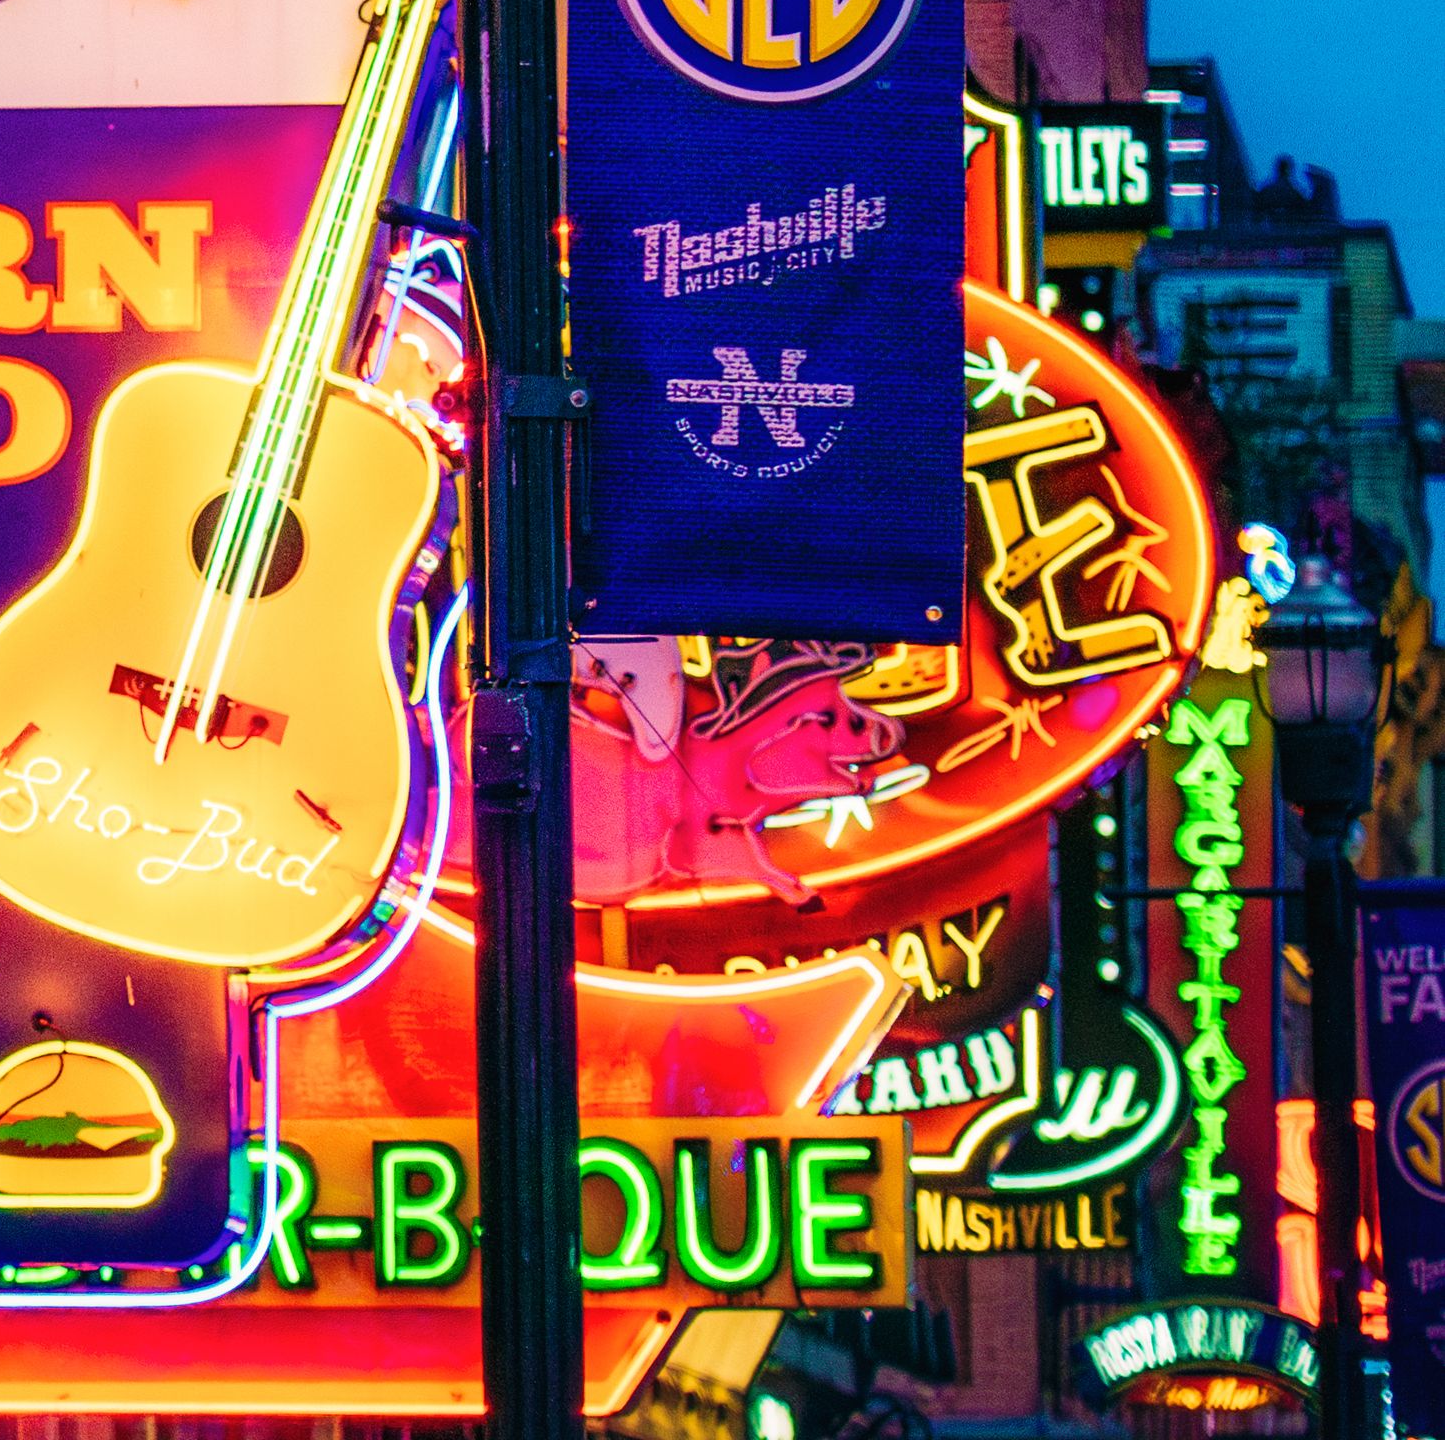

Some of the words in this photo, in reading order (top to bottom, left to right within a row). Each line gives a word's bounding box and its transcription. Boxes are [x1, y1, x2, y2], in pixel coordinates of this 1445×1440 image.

[632, 182, 887, 298] Nashville
[684, 261, 761, 295] MUSIC
[785, 247, 835, 272] CITY
[675, 418, 748, 478] SPORTS
[757, 420, 845, 479] COUNCIL
[915, 1183, 1129, 1251] NASHVILLE
